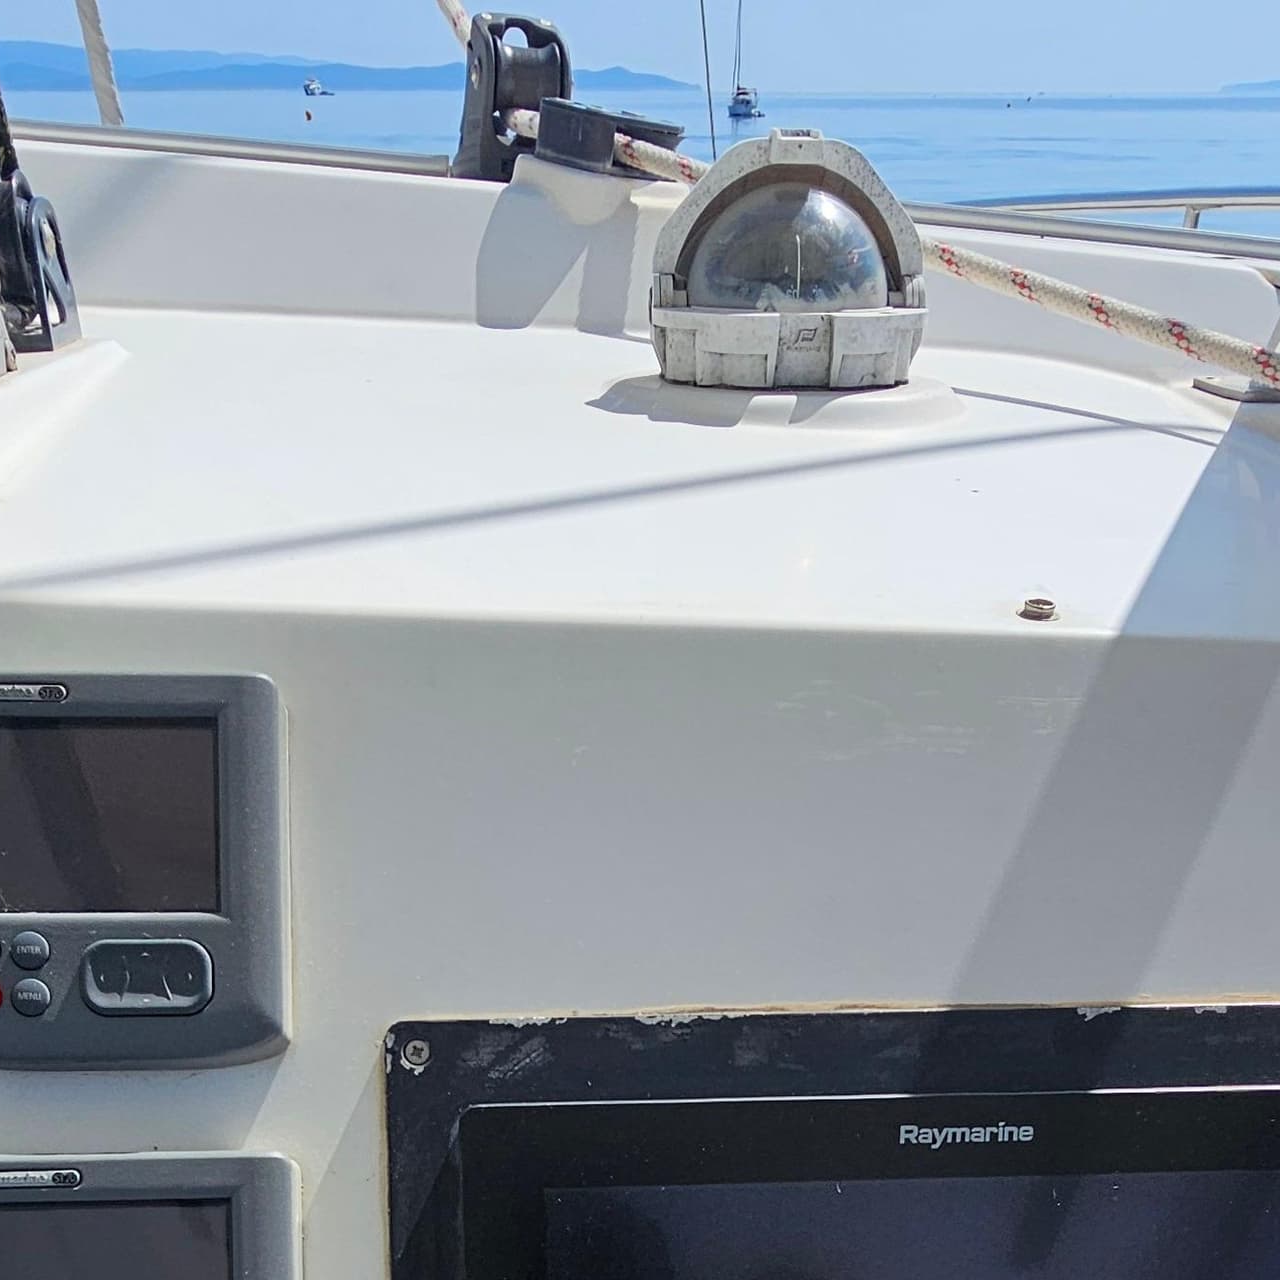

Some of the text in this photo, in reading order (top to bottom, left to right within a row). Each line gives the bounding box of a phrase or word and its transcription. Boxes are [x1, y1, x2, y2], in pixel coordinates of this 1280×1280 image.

[16, 945, 42, 955] ENTER
[17, 991, 41, 1001] MENU
[899, 1121, 1034, 1150] Raymarine
